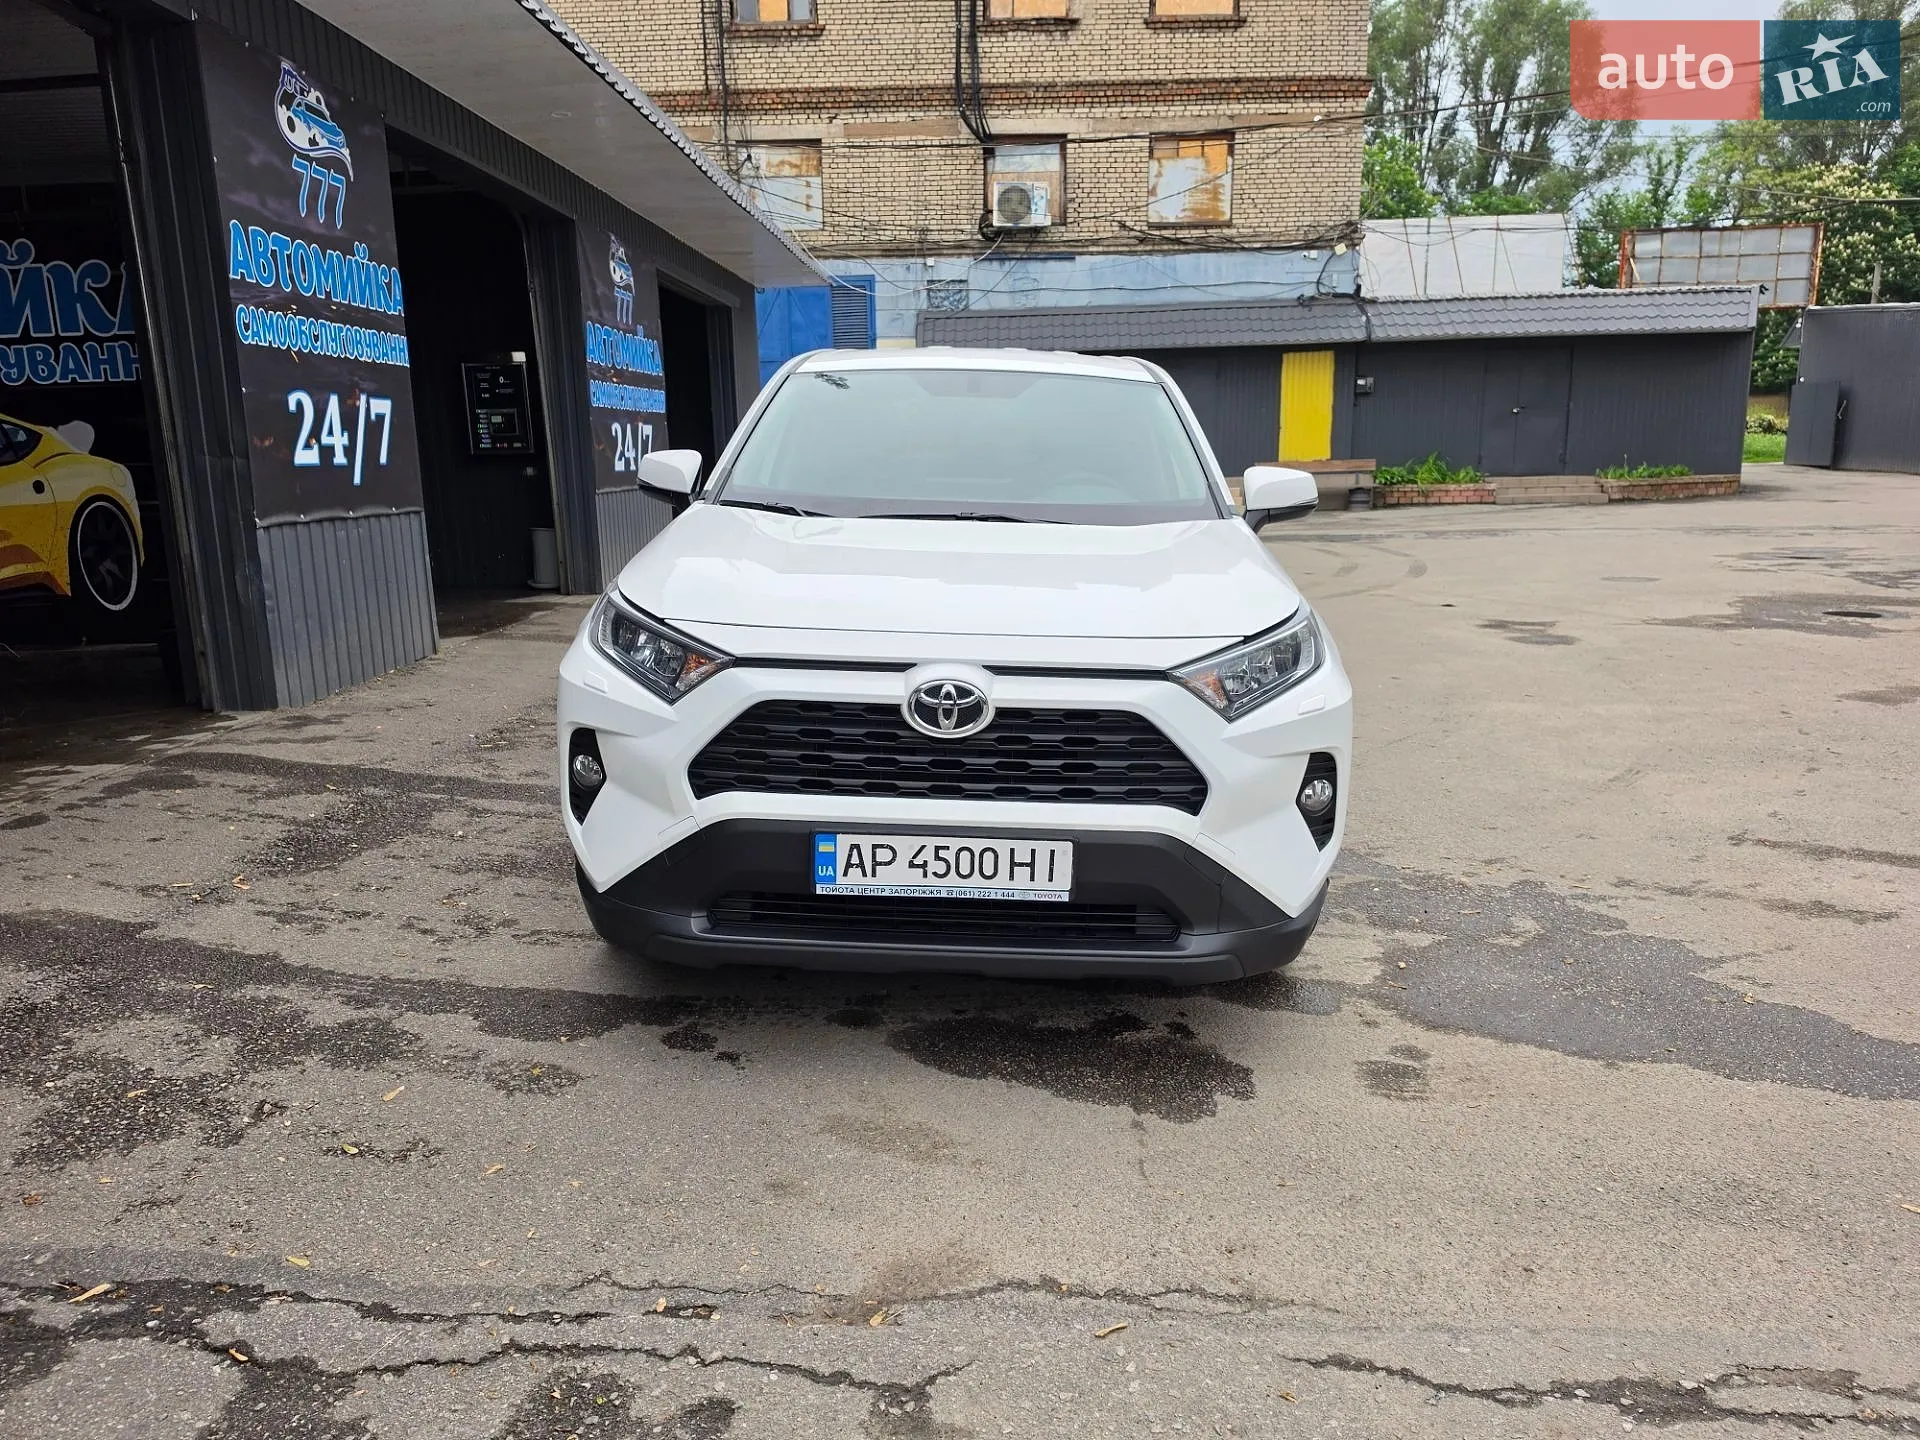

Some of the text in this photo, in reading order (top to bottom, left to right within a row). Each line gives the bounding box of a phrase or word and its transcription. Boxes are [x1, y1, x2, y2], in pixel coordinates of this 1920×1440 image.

[292, 153, 346, 229] 777
[229, 219, 405, 317] АВТОМИЙКА
[614, 286, 633, 325] 777
[235, 304, 411, 368] САМООБСЛУГОВУВАНН
[287, 389, 392, 486] 24/7
[611, 421, 653, 472] 24/7
[818, 866, 834, 877] UA
[842, 843, 1056, 883] AP 4500 HI
[820, 886, 855, 895] ТОЙОТА
[857, 887, 886, 896] ЦЕНТР
[888, 888, 942, 896] ЗАПОРІЖЖЯ
[977, 890, 992, 898] 222
[1000, 891, 1015, 899] 444
[1034, 892, 1063, 900] TOYOTA
